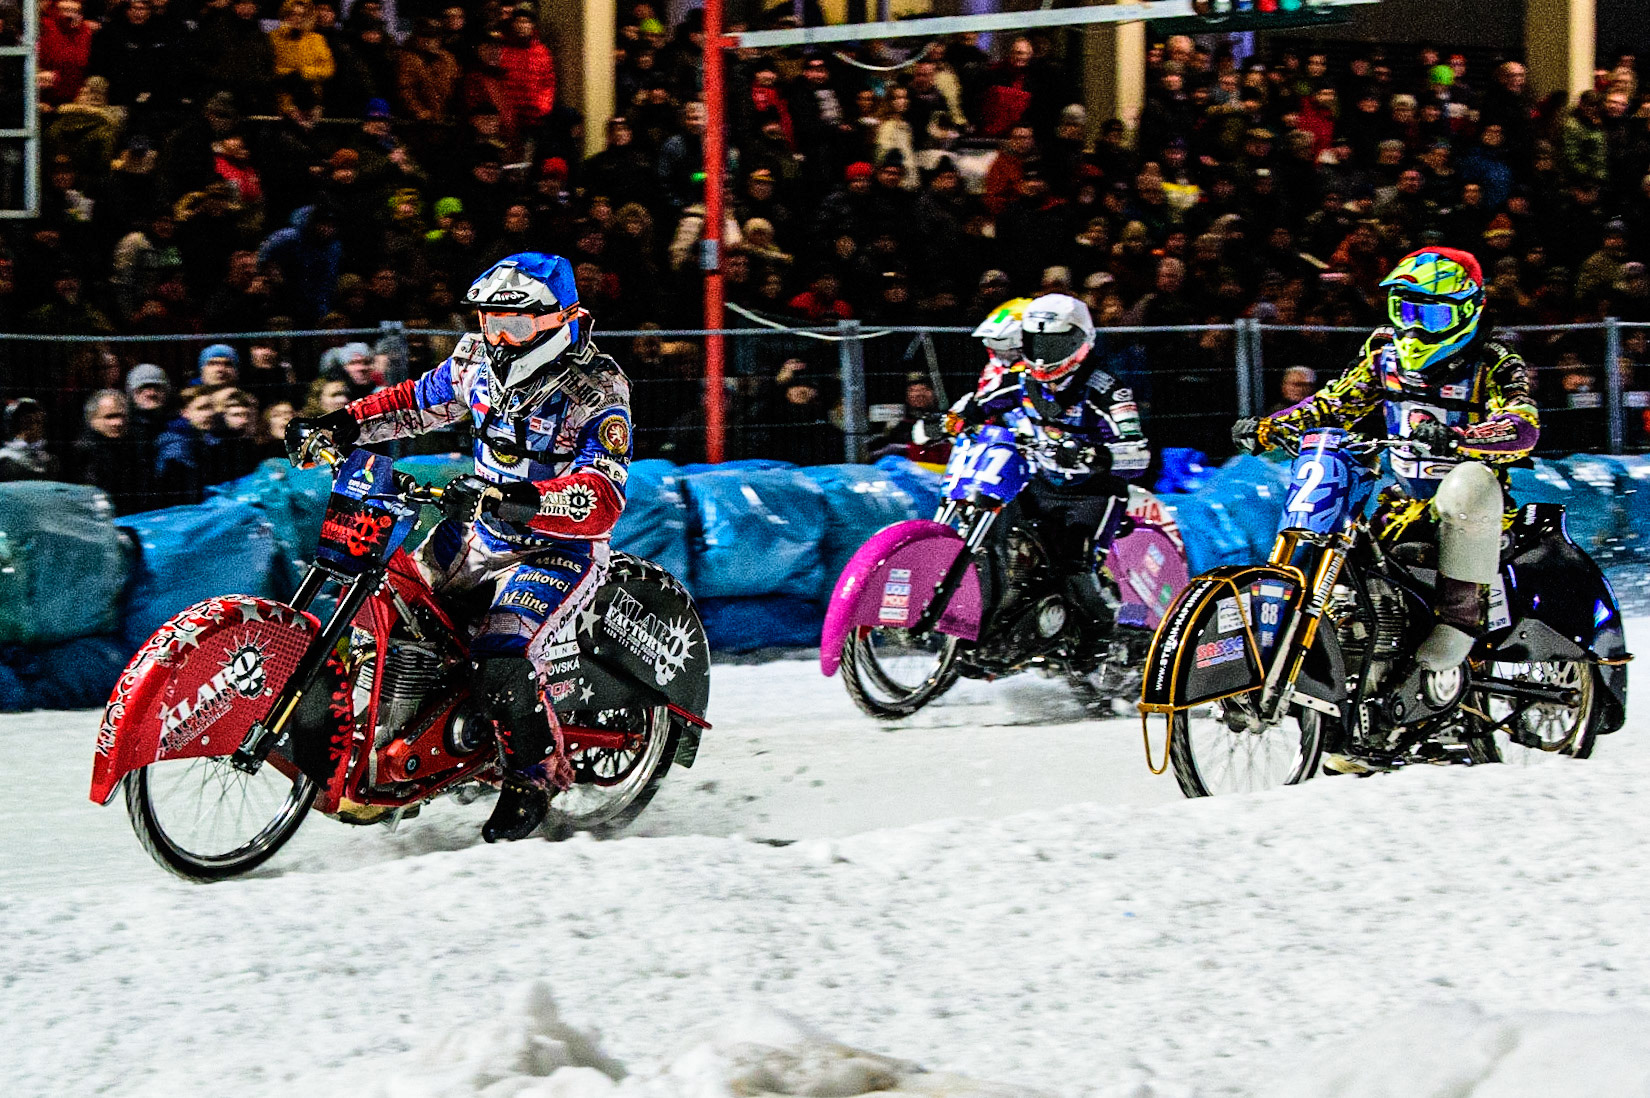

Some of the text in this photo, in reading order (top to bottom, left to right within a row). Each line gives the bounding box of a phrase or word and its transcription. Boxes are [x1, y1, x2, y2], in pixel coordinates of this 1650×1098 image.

[1288, 461, 1325, 513] 2
[1261, 602, 1279, 625] 88
[605, 604, 667, 658] FACTORY
[544, 645, 577, 658] DING
[1196, 635, 1244, 661] SASSE
